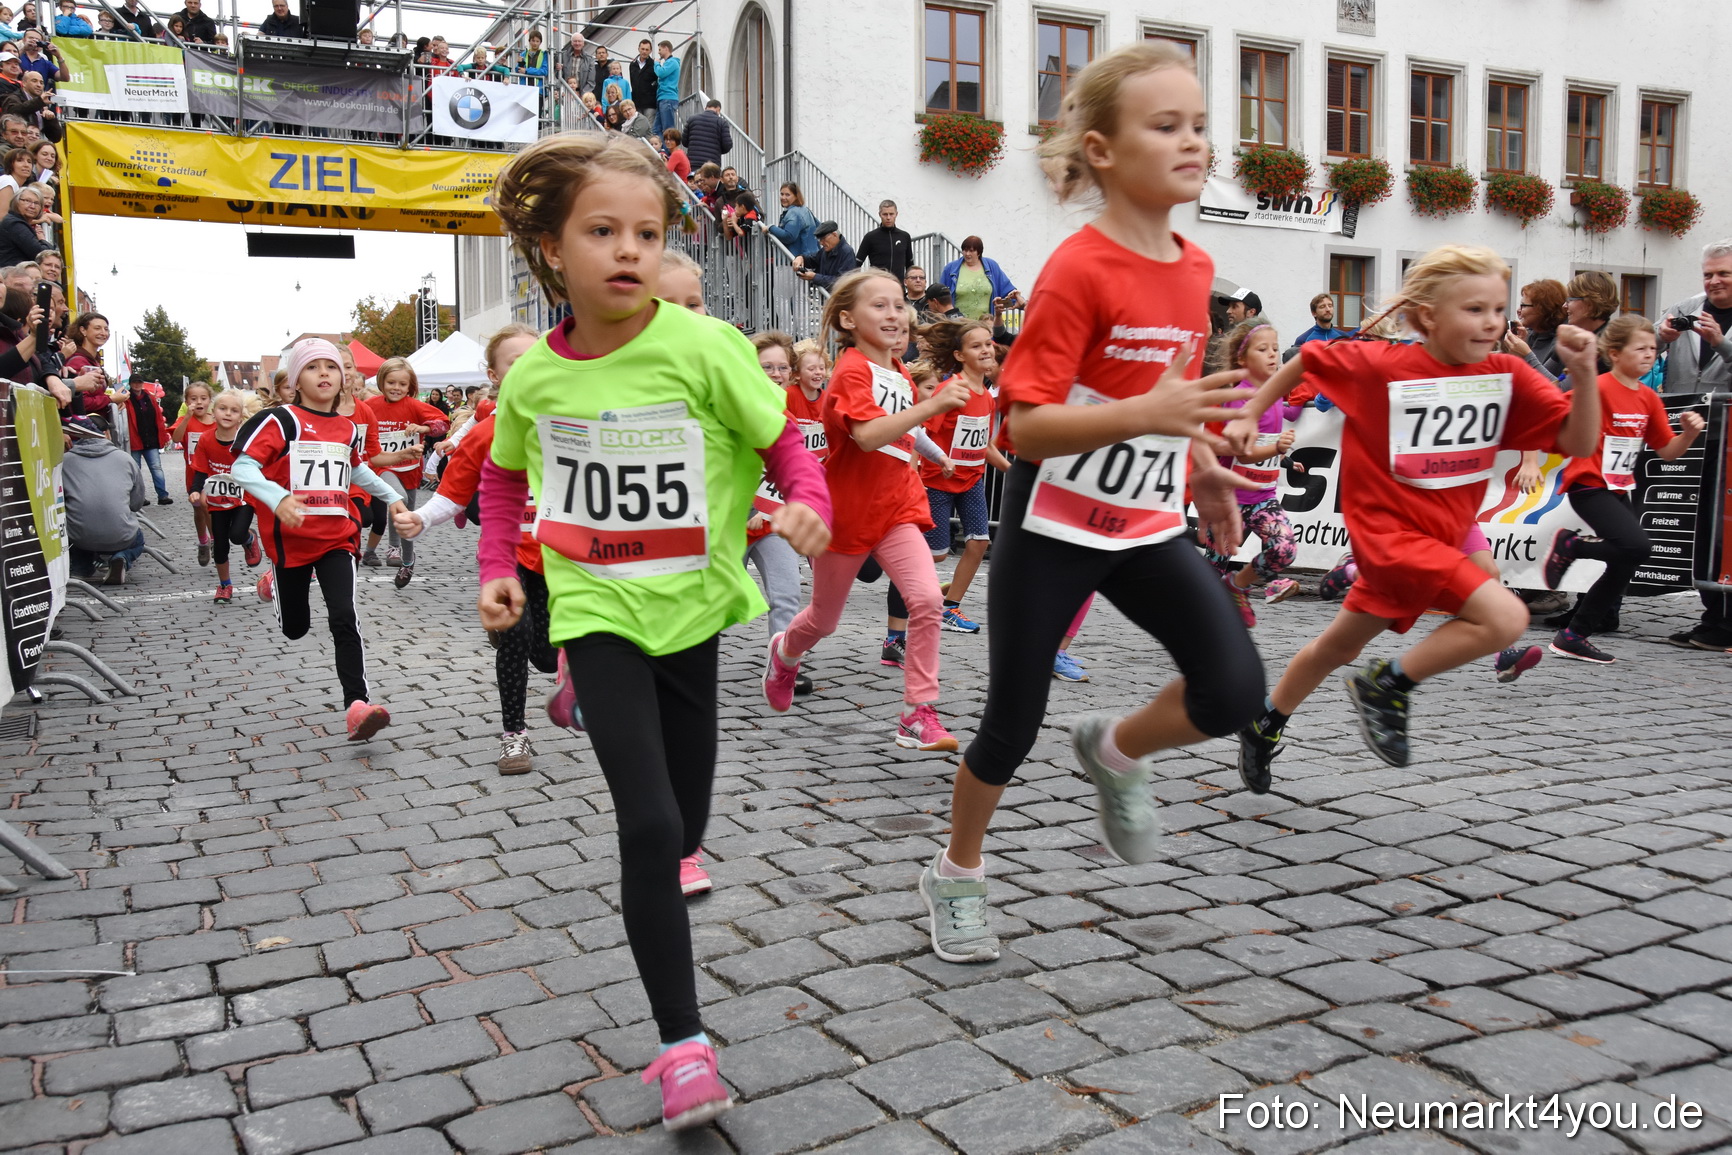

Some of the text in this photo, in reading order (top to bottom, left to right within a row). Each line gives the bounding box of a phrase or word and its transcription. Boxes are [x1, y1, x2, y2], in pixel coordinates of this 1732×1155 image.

[193, 71, 273, 92] BOCK
[124, 88, 178, 97] NeuerMarkt
[192, 87, 219, 95] inspired
[282, 81, 417, 102] OFFICE INDUSTRY LOUNE
[453, 88, 488, 104] BMW
[303, 98, 399, 114] www.bockonline.de
[96, 158, 207, 177] Neumarkter Stadtlauf
[269, 152, 375, 194] ZIEL
[98, 189, 199, 203] Neumarkter Stadtlauf
[431, 183, 484, 193] Neumarkter
[1256, 190, 1313, 214] swn
[400, 208, 485, 219] Neumarkter Stadtlauf
[1254, 212, 1326, 226] stadtwerke neumarkt
[879, 383, 914, 415] 716
[1405, 402, 1501, 448] 7220
[600, 427, 687, 448] BOCK
[804, 433, 826, 449] 108
[300, 460, 350, 489] 7170
[1065, 442, 1176, 503] 7074
[1421, 457, 1480, 475] Johanna
[1661, 464, 1687, 472] Wasser
[556, 456, 689, 522] 7055
[1657, 490, 1683, 500] Wärme
[1087, 507, 1127, 533] Lisa
[1652, 517, 1680, 527] Freizeit
[1293, 520, 1350, 547] adtw
[588, 537, 645, 560] Anna
[1651, 544, 1681, 554] dtbusse
[10, 563, 35, 578] Freizeit
[1634, 570, 1680, 582] Parkhäuser
[14, 601, 50, 619] Stadtbusse
